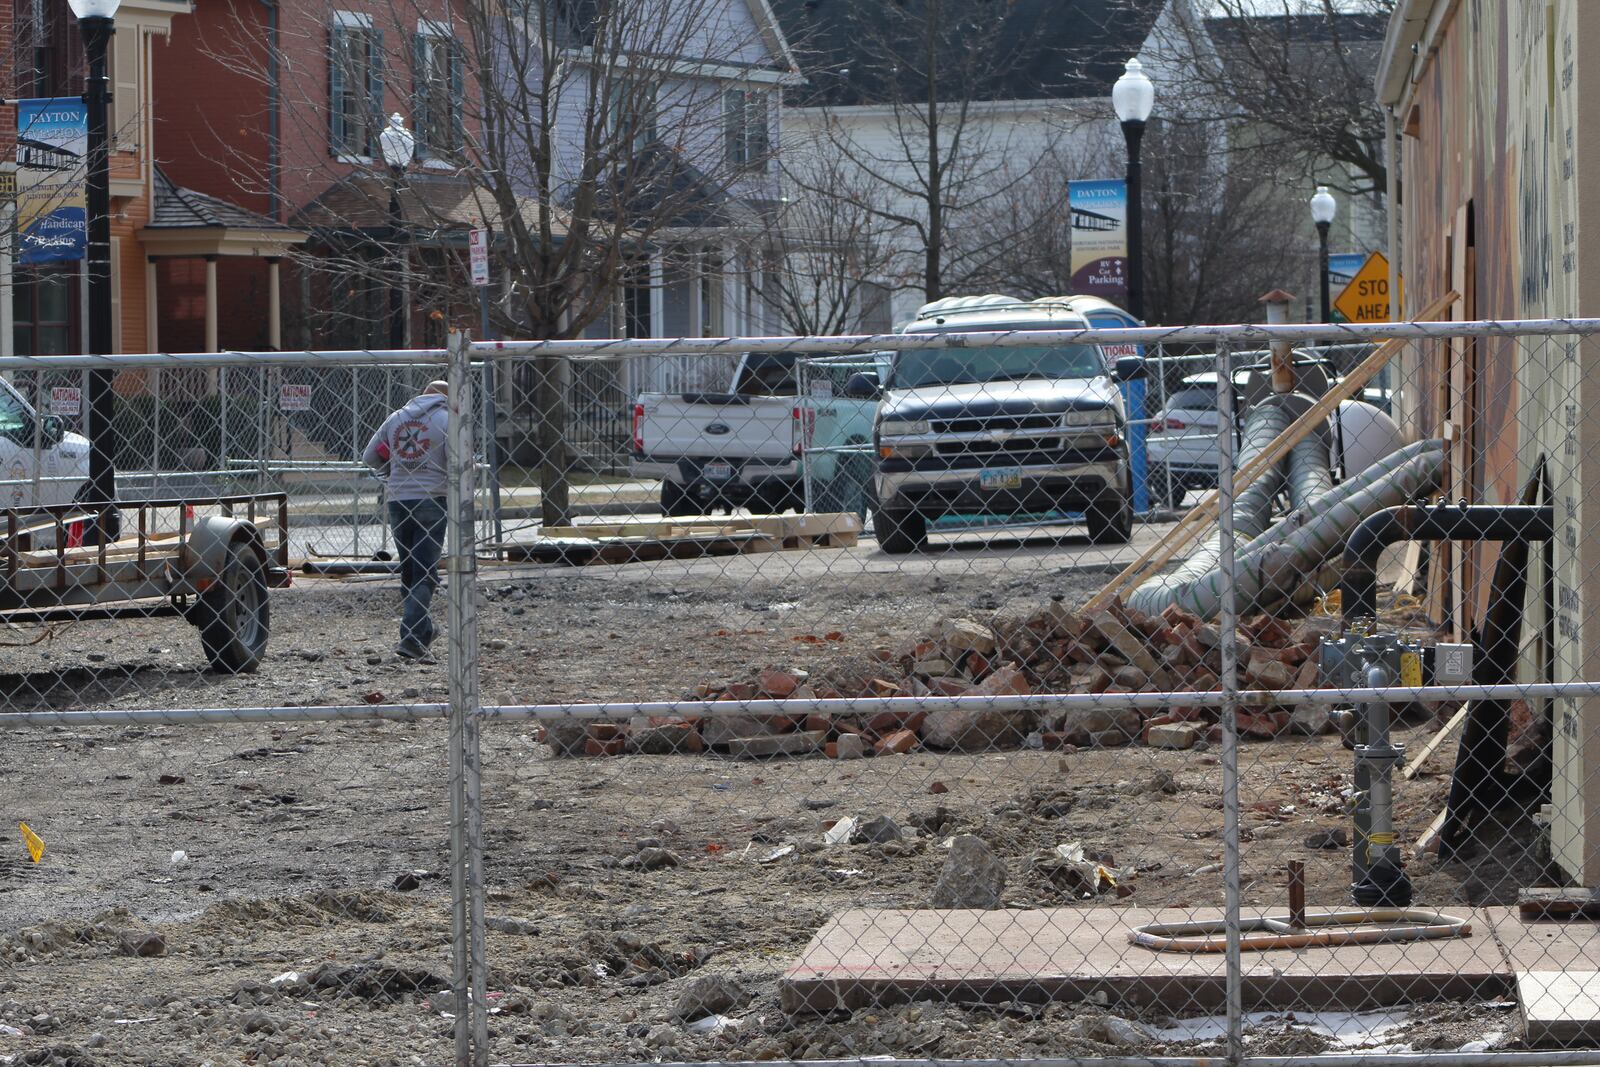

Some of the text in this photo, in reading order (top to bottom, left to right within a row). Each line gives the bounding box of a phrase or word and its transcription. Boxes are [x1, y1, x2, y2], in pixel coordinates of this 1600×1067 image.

[29, 111, 80, 124] DAYTON
[1077, 189, 1117, 198] DAYTON
[40, 218, 85, 231] Handicap
[1099, 267, 1111, 275] Car
[1088, 275, 1124, 286] Parking
[1358, 279, 1389, 297] STO
[1104, 344, 1136, 356] TIONAL
[53, 388, 80, 401] NATIONAL
[282, 386, 310, 398] NATIONAL
